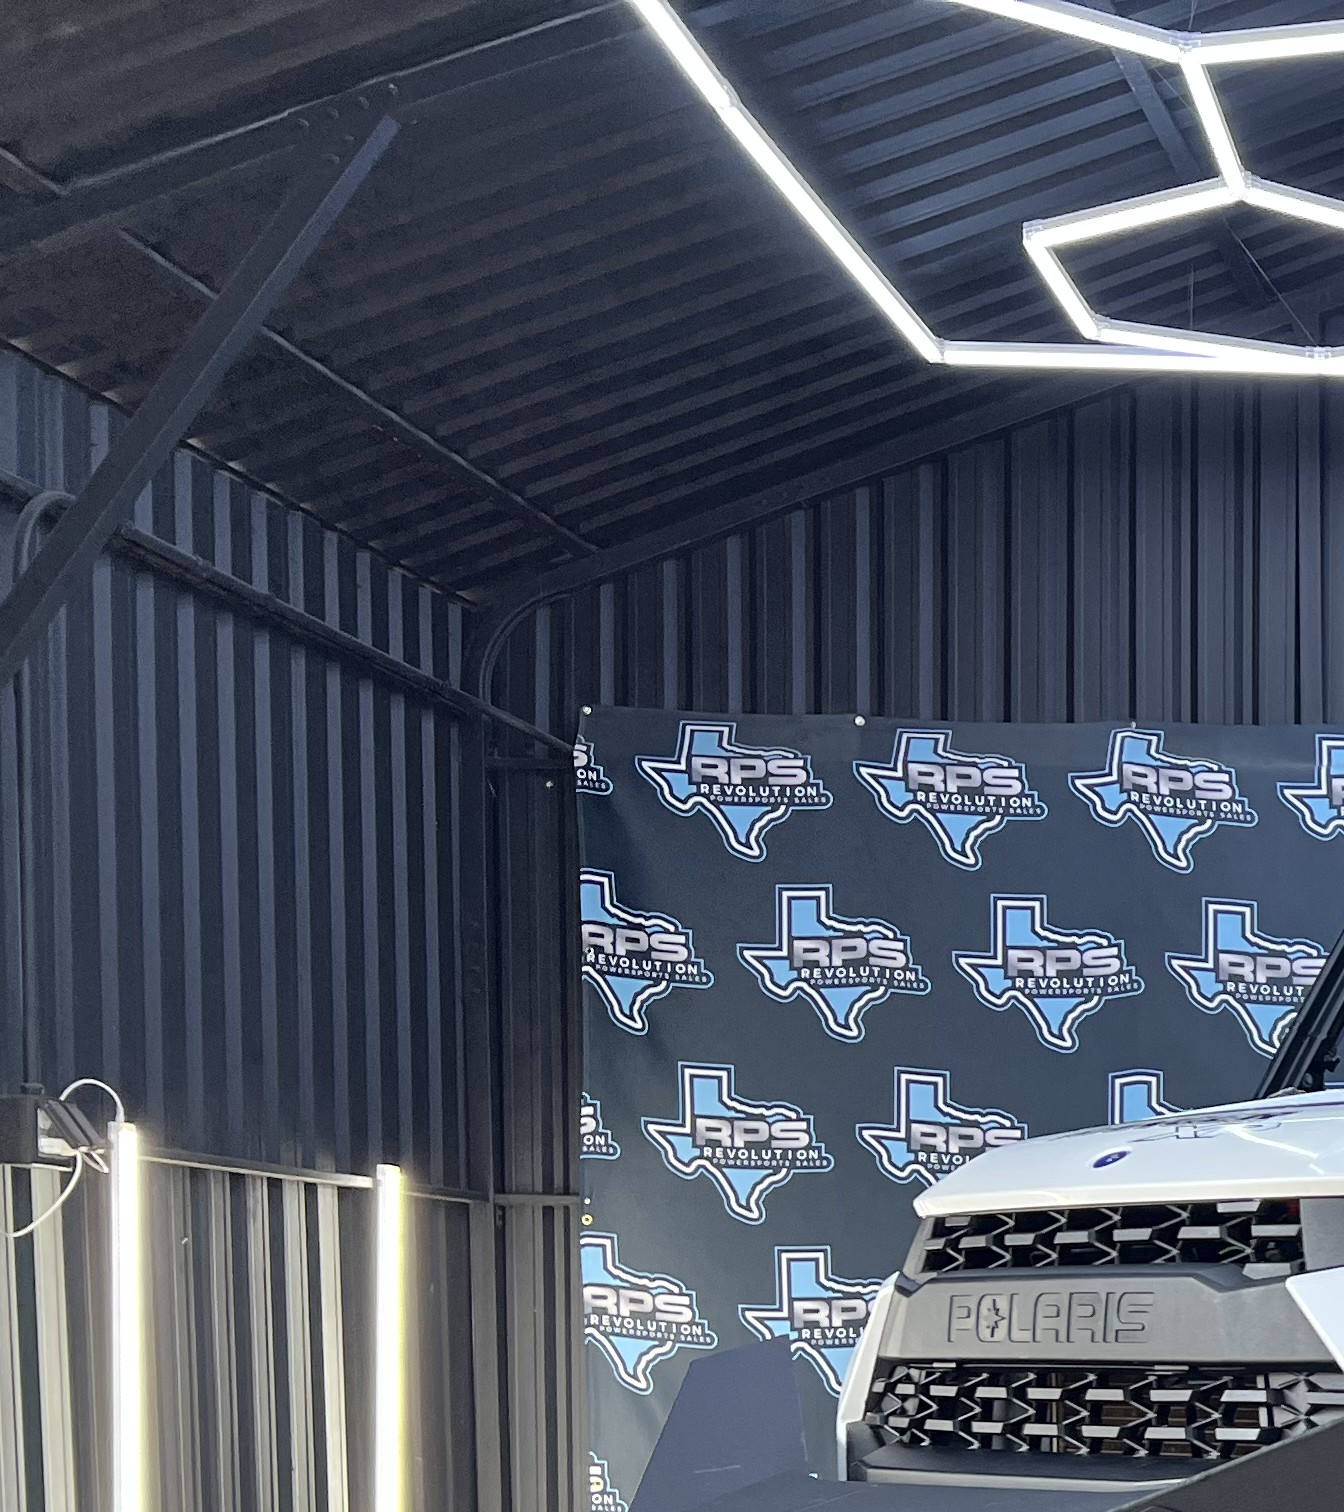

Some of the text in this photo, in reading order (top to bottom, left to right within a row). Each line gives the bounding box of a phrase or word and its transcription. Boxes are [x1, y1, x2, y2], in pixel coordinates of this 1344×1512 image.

[692, 756, 807, 784] RPS
[909, 764, 1020, 796] RPS
[1123, 764, 1232, 800] RPS
[700, 784, 816, 797] REVOLUTION
[917, 791, 1032, 807] REVOLUTION
[1131, 792, 1241, 812] REVOLUTION
[582, 924, 688, 961] RPS
[794, 938, 907, 966] RPS
[587, 953, 697, 974] REVOLUTION
[801, 968, 916, 980] REVOLUTION
[1008, 947, 1120, 976] RPS
[1219, 953, 1327, 985] RPS
[1016, 975, 1130, 988] REVOLUTION
[1227, 982, 1304, 996] REVOLUT
[1236, 993, 1305, 1003] POWERSPORT
[696, 1118, 809, 1148] RPS
[704, 1148, 818, 1160] REVOLUTION
[584, 1284, 692, 1323] RPS
[794, 1299, 872, 1328] RP
[947, 1292, 1155, 1343] POLARIS
[592, 1314, 701, 1335] REVOLUTION
